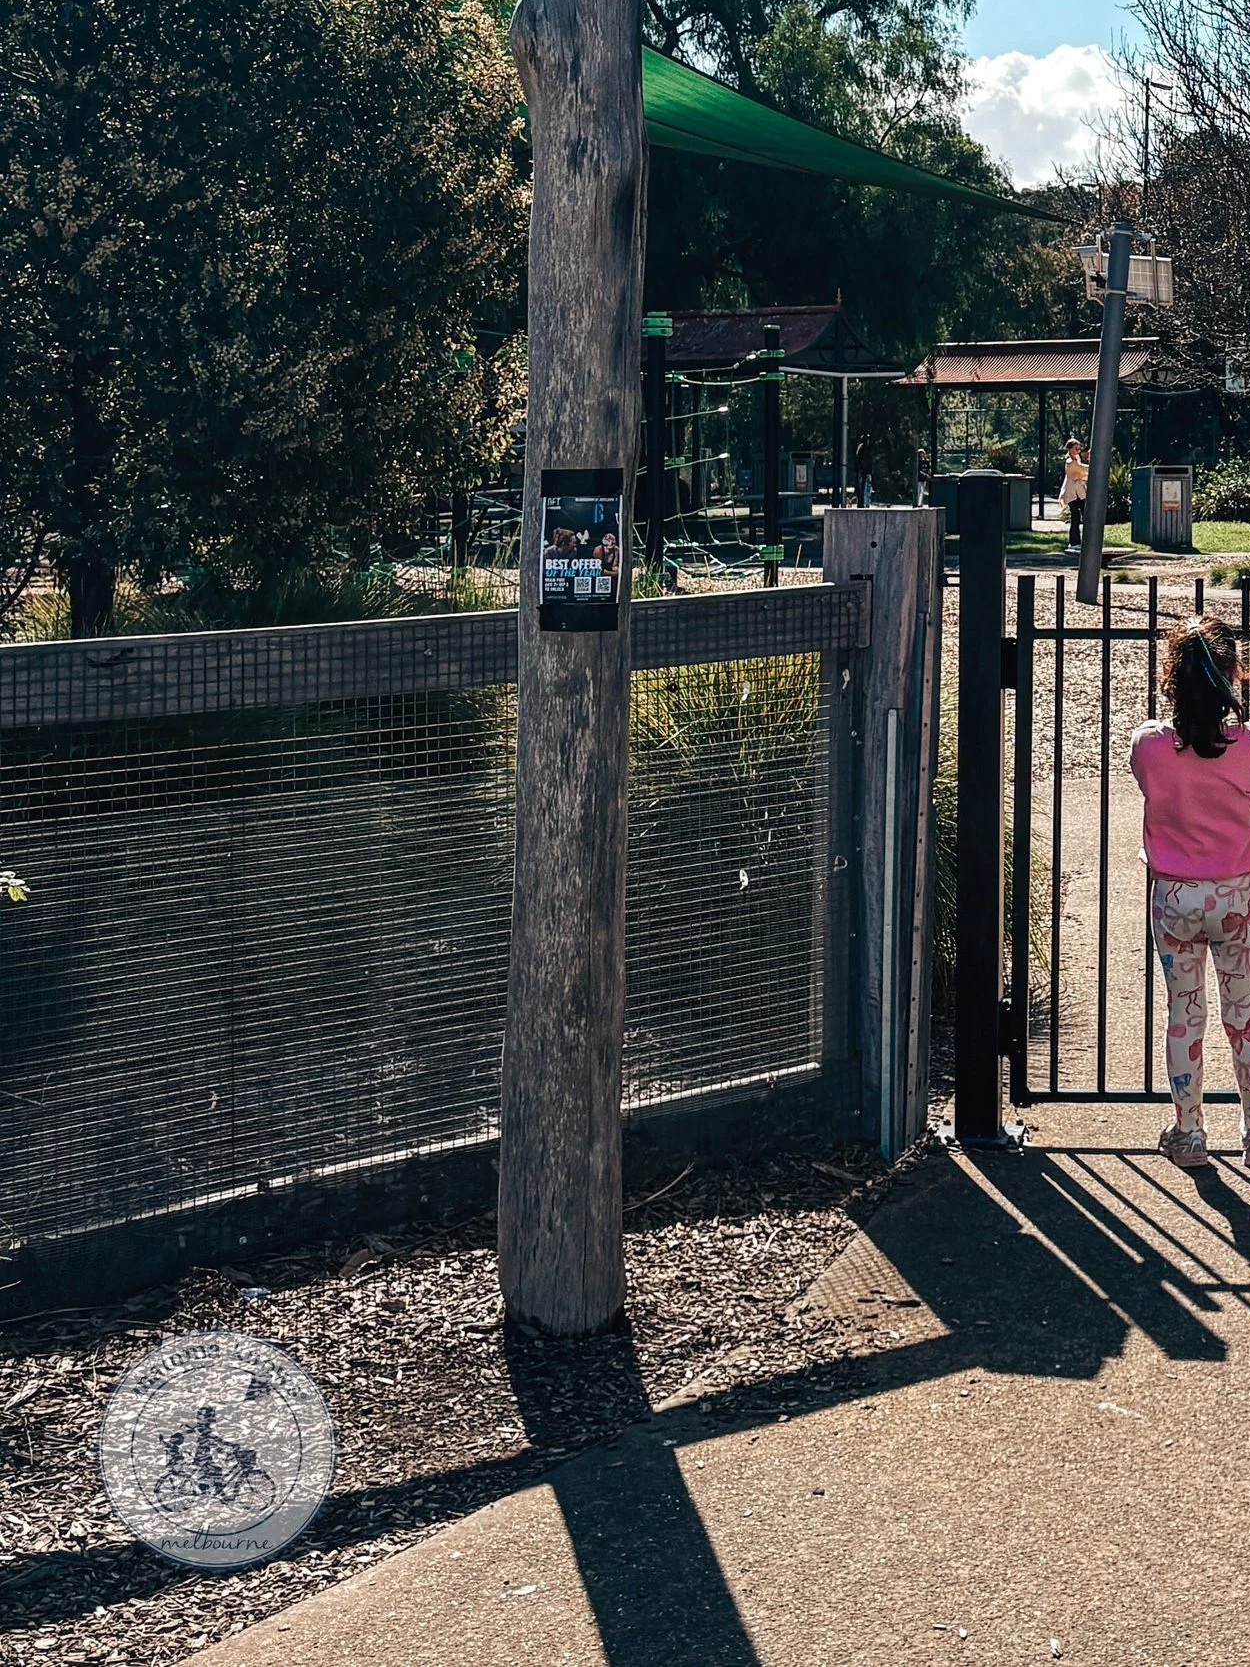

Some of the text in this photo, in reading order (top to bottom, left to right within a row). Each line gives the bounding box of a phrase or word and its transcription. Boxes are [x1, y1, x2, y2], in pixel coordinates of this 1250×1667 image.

[545, 559, 602, 570] BEST OFFER
[546, 568, 602, 577] OF THE YEAR
